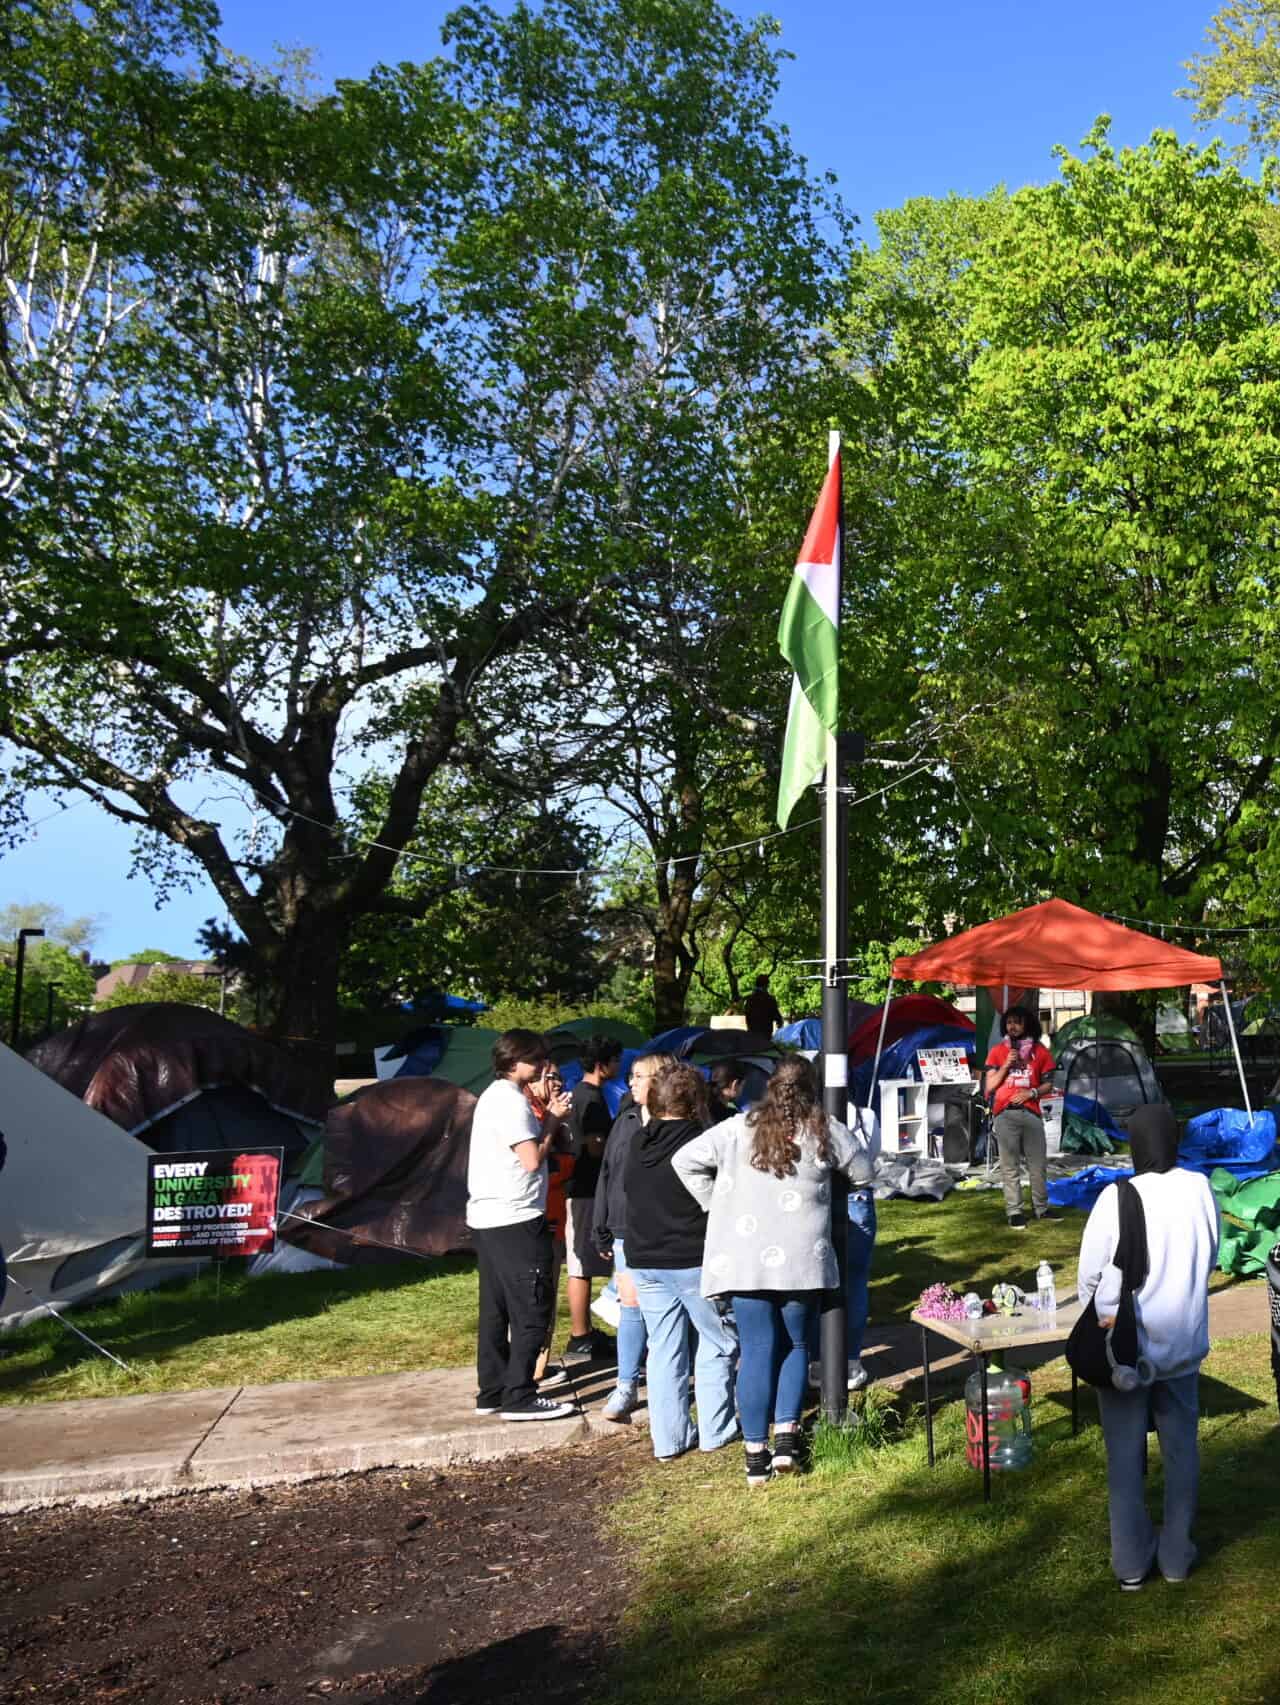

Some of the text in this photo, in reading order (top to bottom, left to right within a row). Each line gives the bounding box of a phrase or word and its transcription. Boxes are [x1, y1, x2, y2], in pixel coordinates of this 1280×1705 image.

[154, 1163, 208, 1178] EVERY
[155, 1175, 251, 1192] UNIVERSITY
[155, 1191, 217, 1206] IN GAZA
[154, 1203, 252, 1221] DESTROYED!
